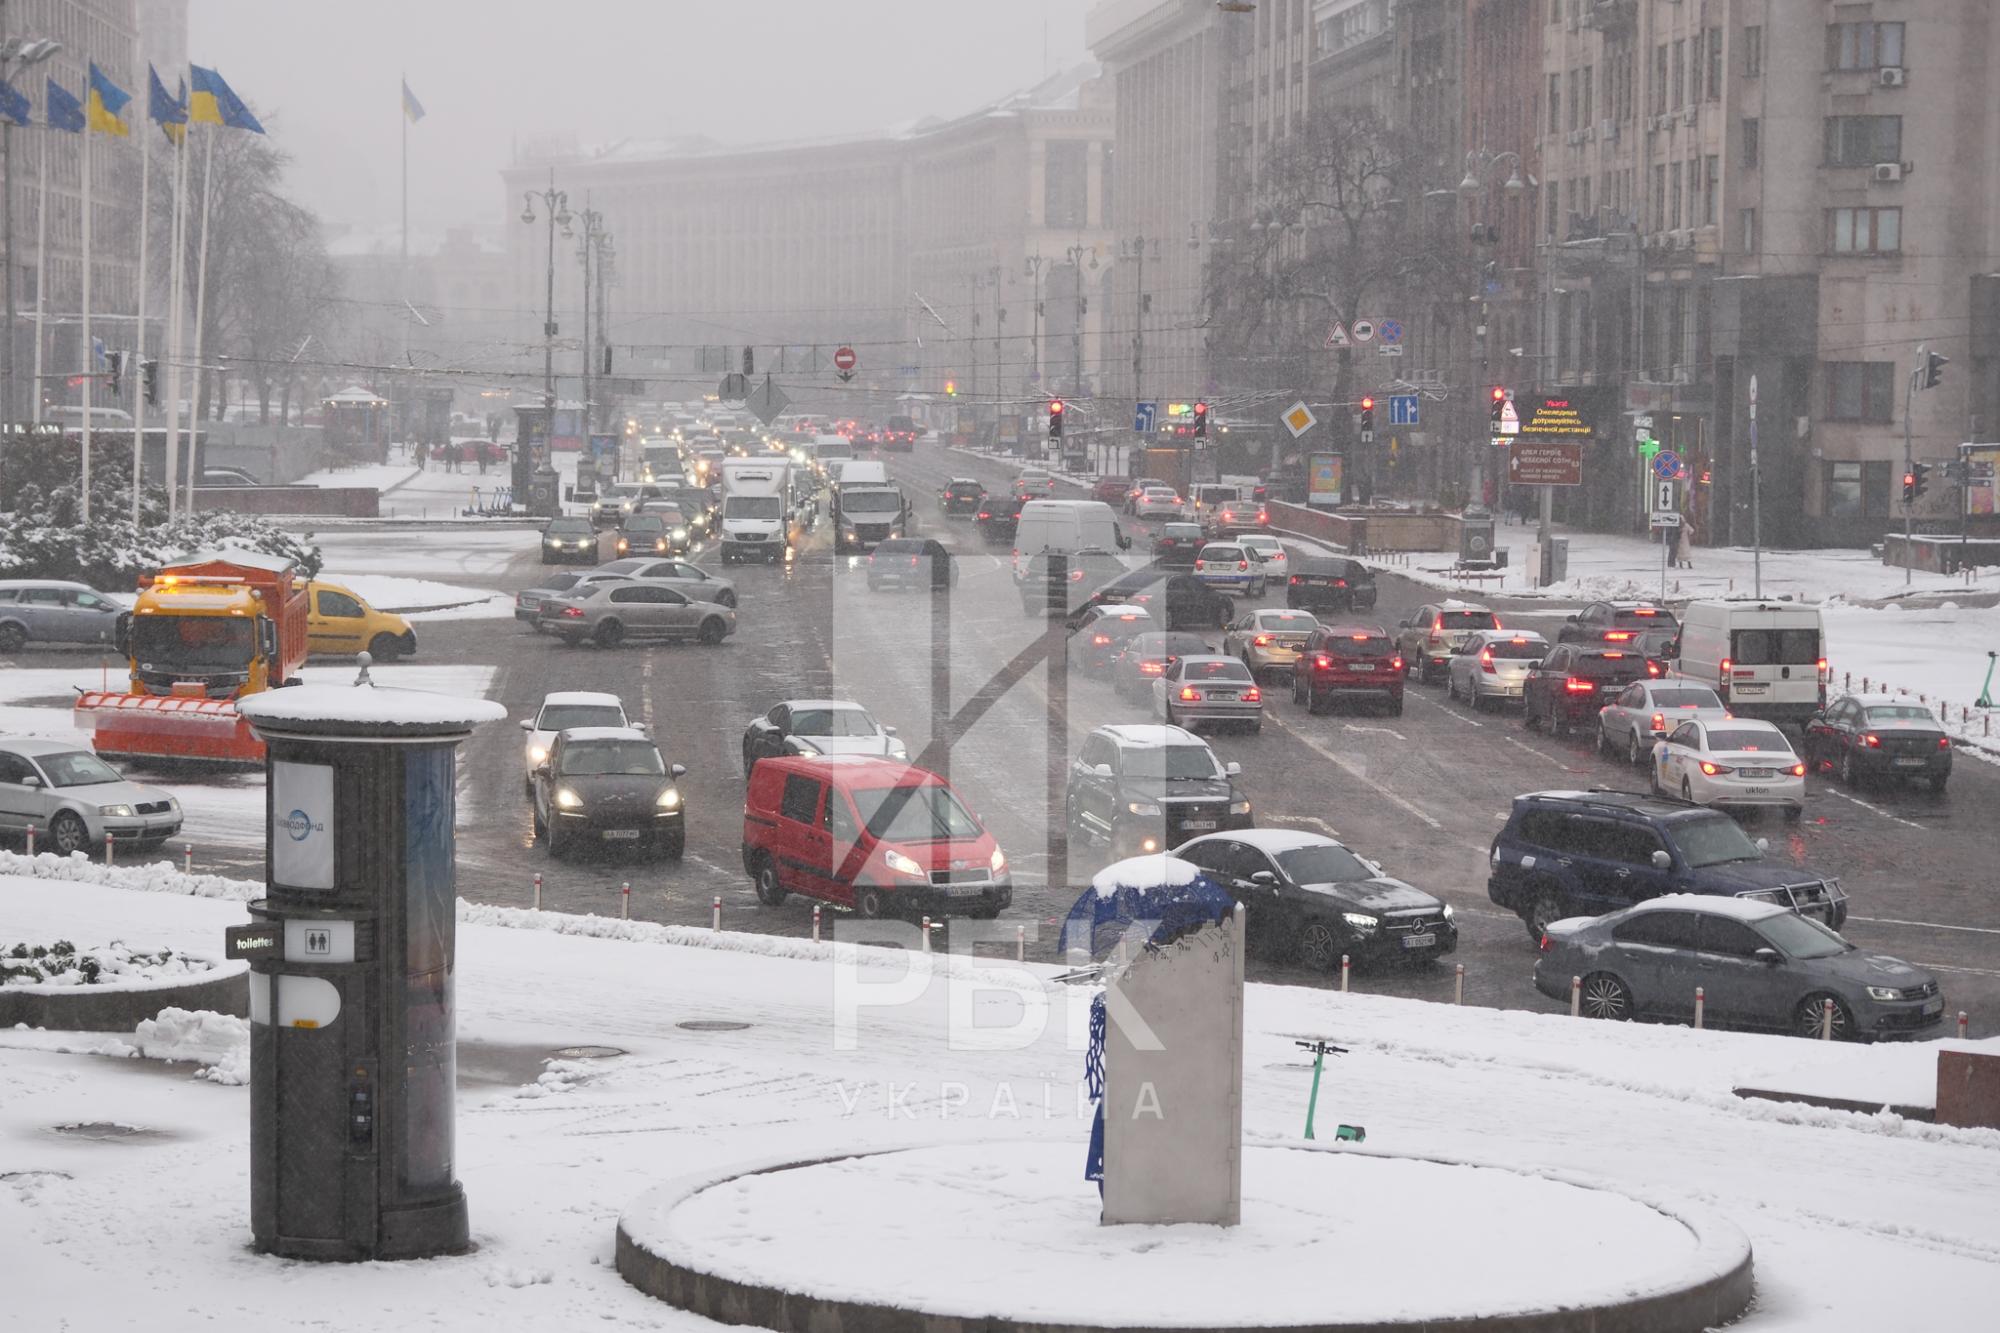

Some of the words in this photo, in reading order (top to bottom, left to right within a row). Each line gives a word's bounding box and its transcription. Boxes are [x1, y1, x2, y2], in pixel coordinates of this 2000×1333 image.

[1536, 408, 1577, 416] Ожеледиця
[1532, 417, 1581, 425] дотримуйтесь
[1522, 425, 1558, 433] безпечної
[1745, 786, 1769, 794] uklon
[236, 937, 274, 950] toilettes
